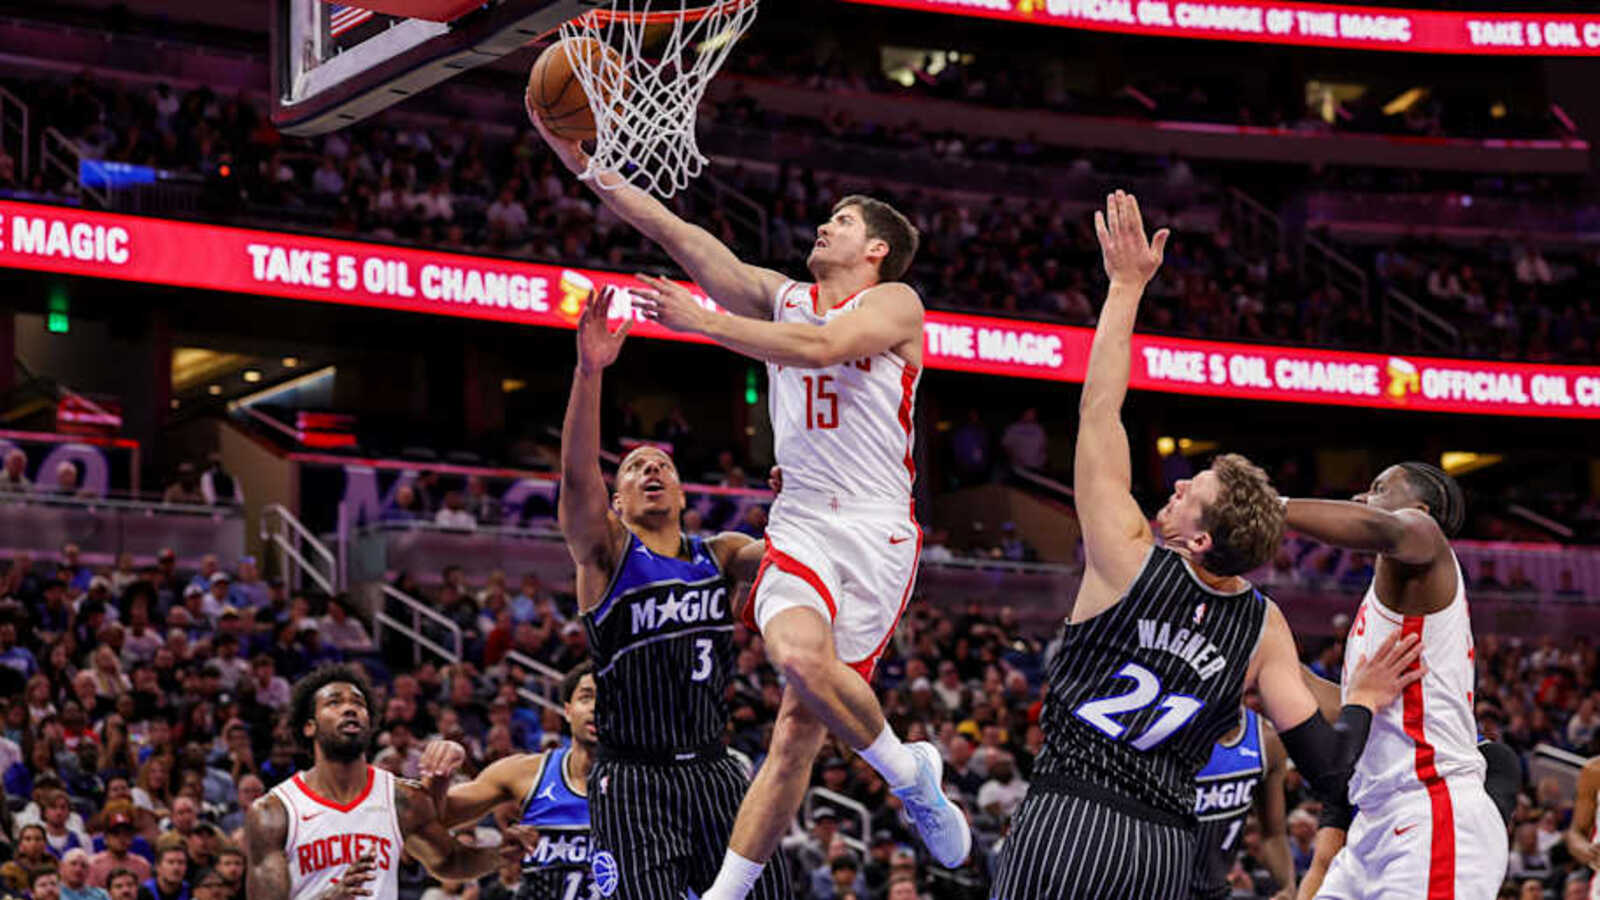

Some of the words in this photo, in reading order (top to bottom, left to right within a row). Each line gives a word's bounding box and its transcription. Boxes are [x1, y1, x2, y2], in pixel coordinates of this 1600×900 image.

[1137, 1, 1172, 26] OIL
[1174, 2, 1264, 33] CHANGE
[1265, 9, 1294, 34] OF
[1296, 11, 1337, 37] THE
[1339, 14, 1412, 42] MAGIC
[1466, 20, 1525, 46] TAKE
[1526, 22, 1542, 46] 5
[1544, 21, 1581, 47] OIL
[12, 216, 129, 264] MAGIC
[247, 244, 331, 288] TAKE
[336, 256, 357, 290] 5
[363, 258, 415, 297] OIL
[420, 264, 549, 312] CHANGE
[923, 322, 976, 358] THE
[977, 328, 1063, 368] MAGIC
[1142, 347, 1207, 383] TAKE
[1208, 354, 1227, 384] 5
[1229, 354, 1273, 388] OIL
[1275, 358, 1380, 396] CHANGE
[1422, 367, 1529, 404] OFFICIAL
[1531, 374, 1573, 406] OIL
[803, 375, 839, 431] 15
[630, 586, 726, 635] MAGIC
[691, 638, 713, 681] 3
[1137, 618, 1227, 682] WAGNER
[1072, 662, 1206, 751] 21
